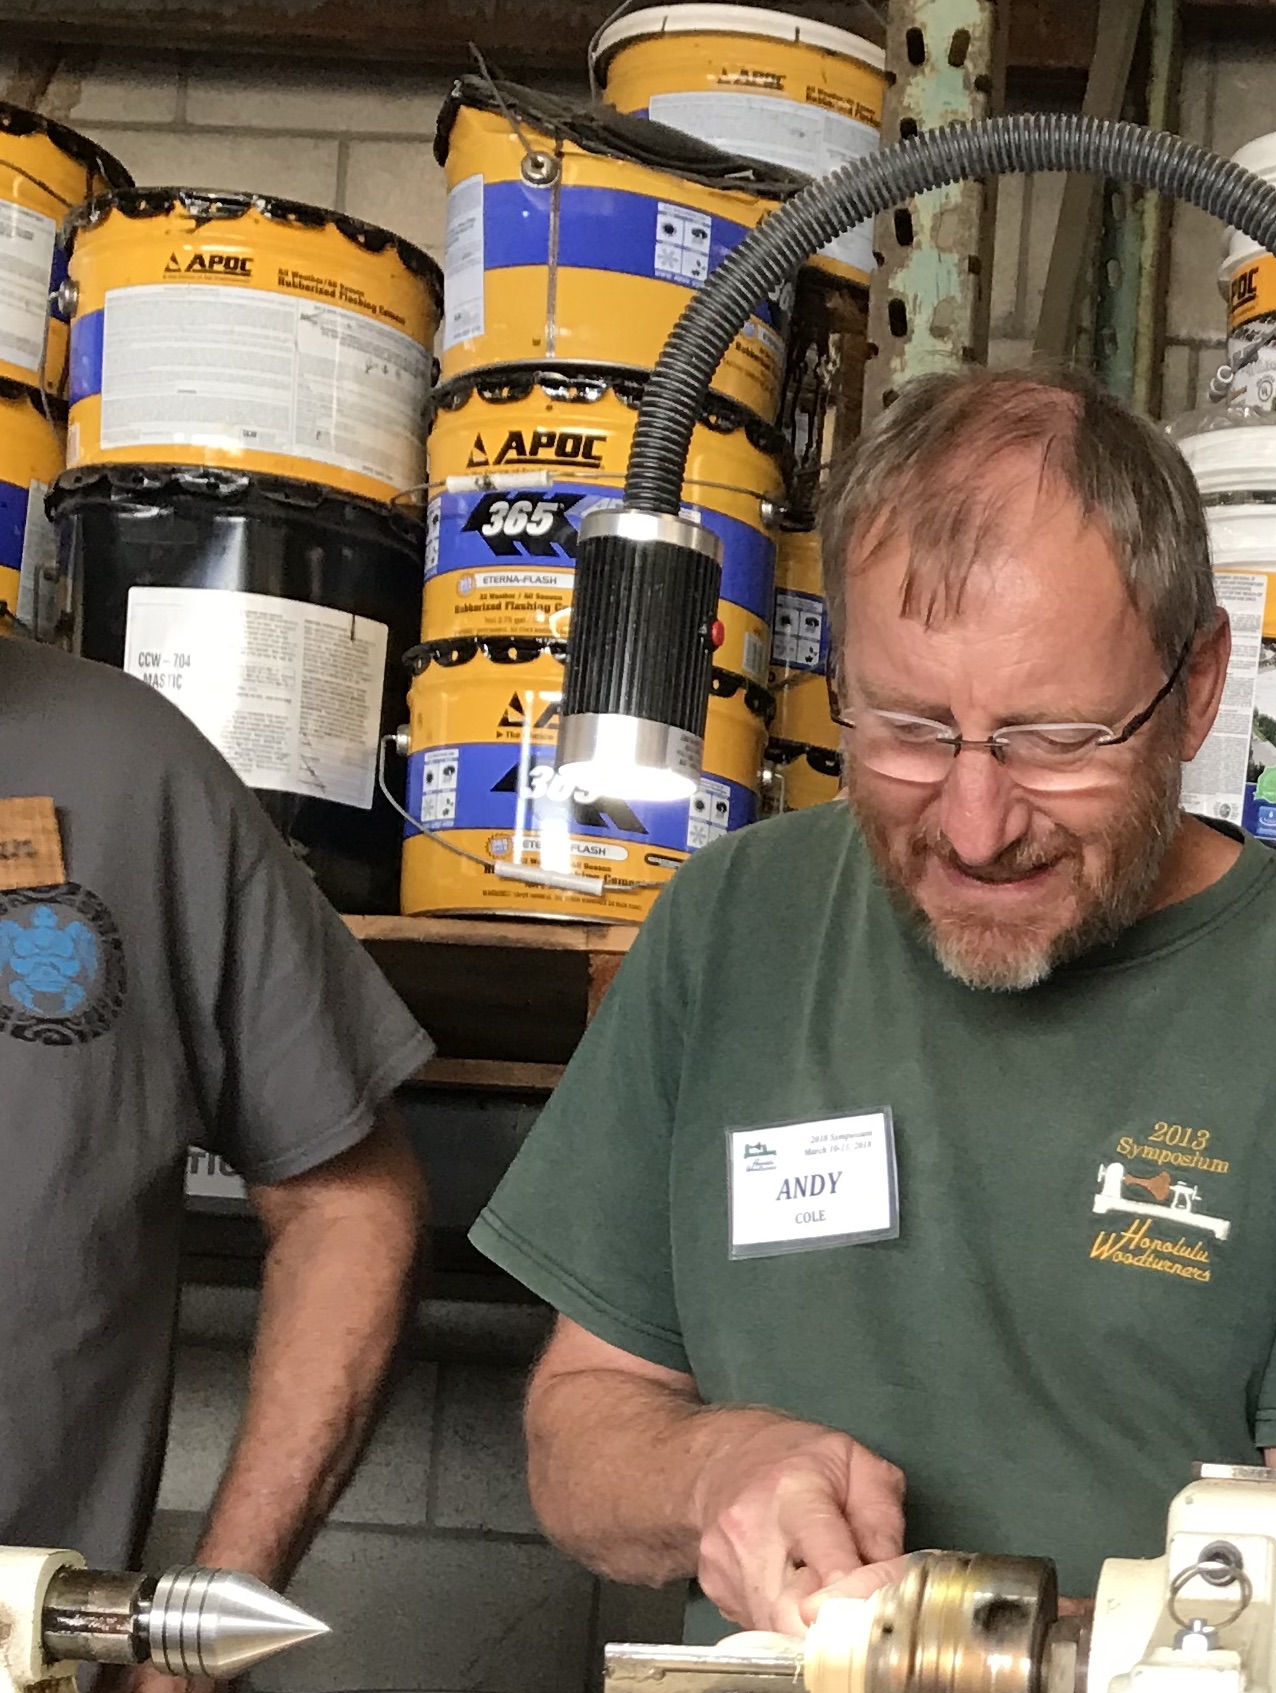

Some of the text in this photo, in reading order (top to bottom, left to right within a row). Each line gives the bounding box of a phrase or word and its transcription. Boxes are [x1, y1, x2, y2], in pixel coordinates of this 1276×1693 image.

[185, 253, 254, 274] APOC
[493, 430, 608, 467] APOC
[481, 500, 559, 537] 365
[482, 575, 557, 585] ETERNA-FLASH
[138, 652, 161, 667] CCW
[174, 652, 191, 668] 704
[143, 672, 183, 690] MASTIC
[1148, 1121, 1210, 1151] 2013
[1116, 1136, 1230, 1174] Symposium
[775, 1171, 844, 1202] ANDY
[795, 1210, 827, 1224] COLE
[1120, 1218, 1210, 1262] Honolulu
[1090, 1230, 1211, 1282] Woodturners
